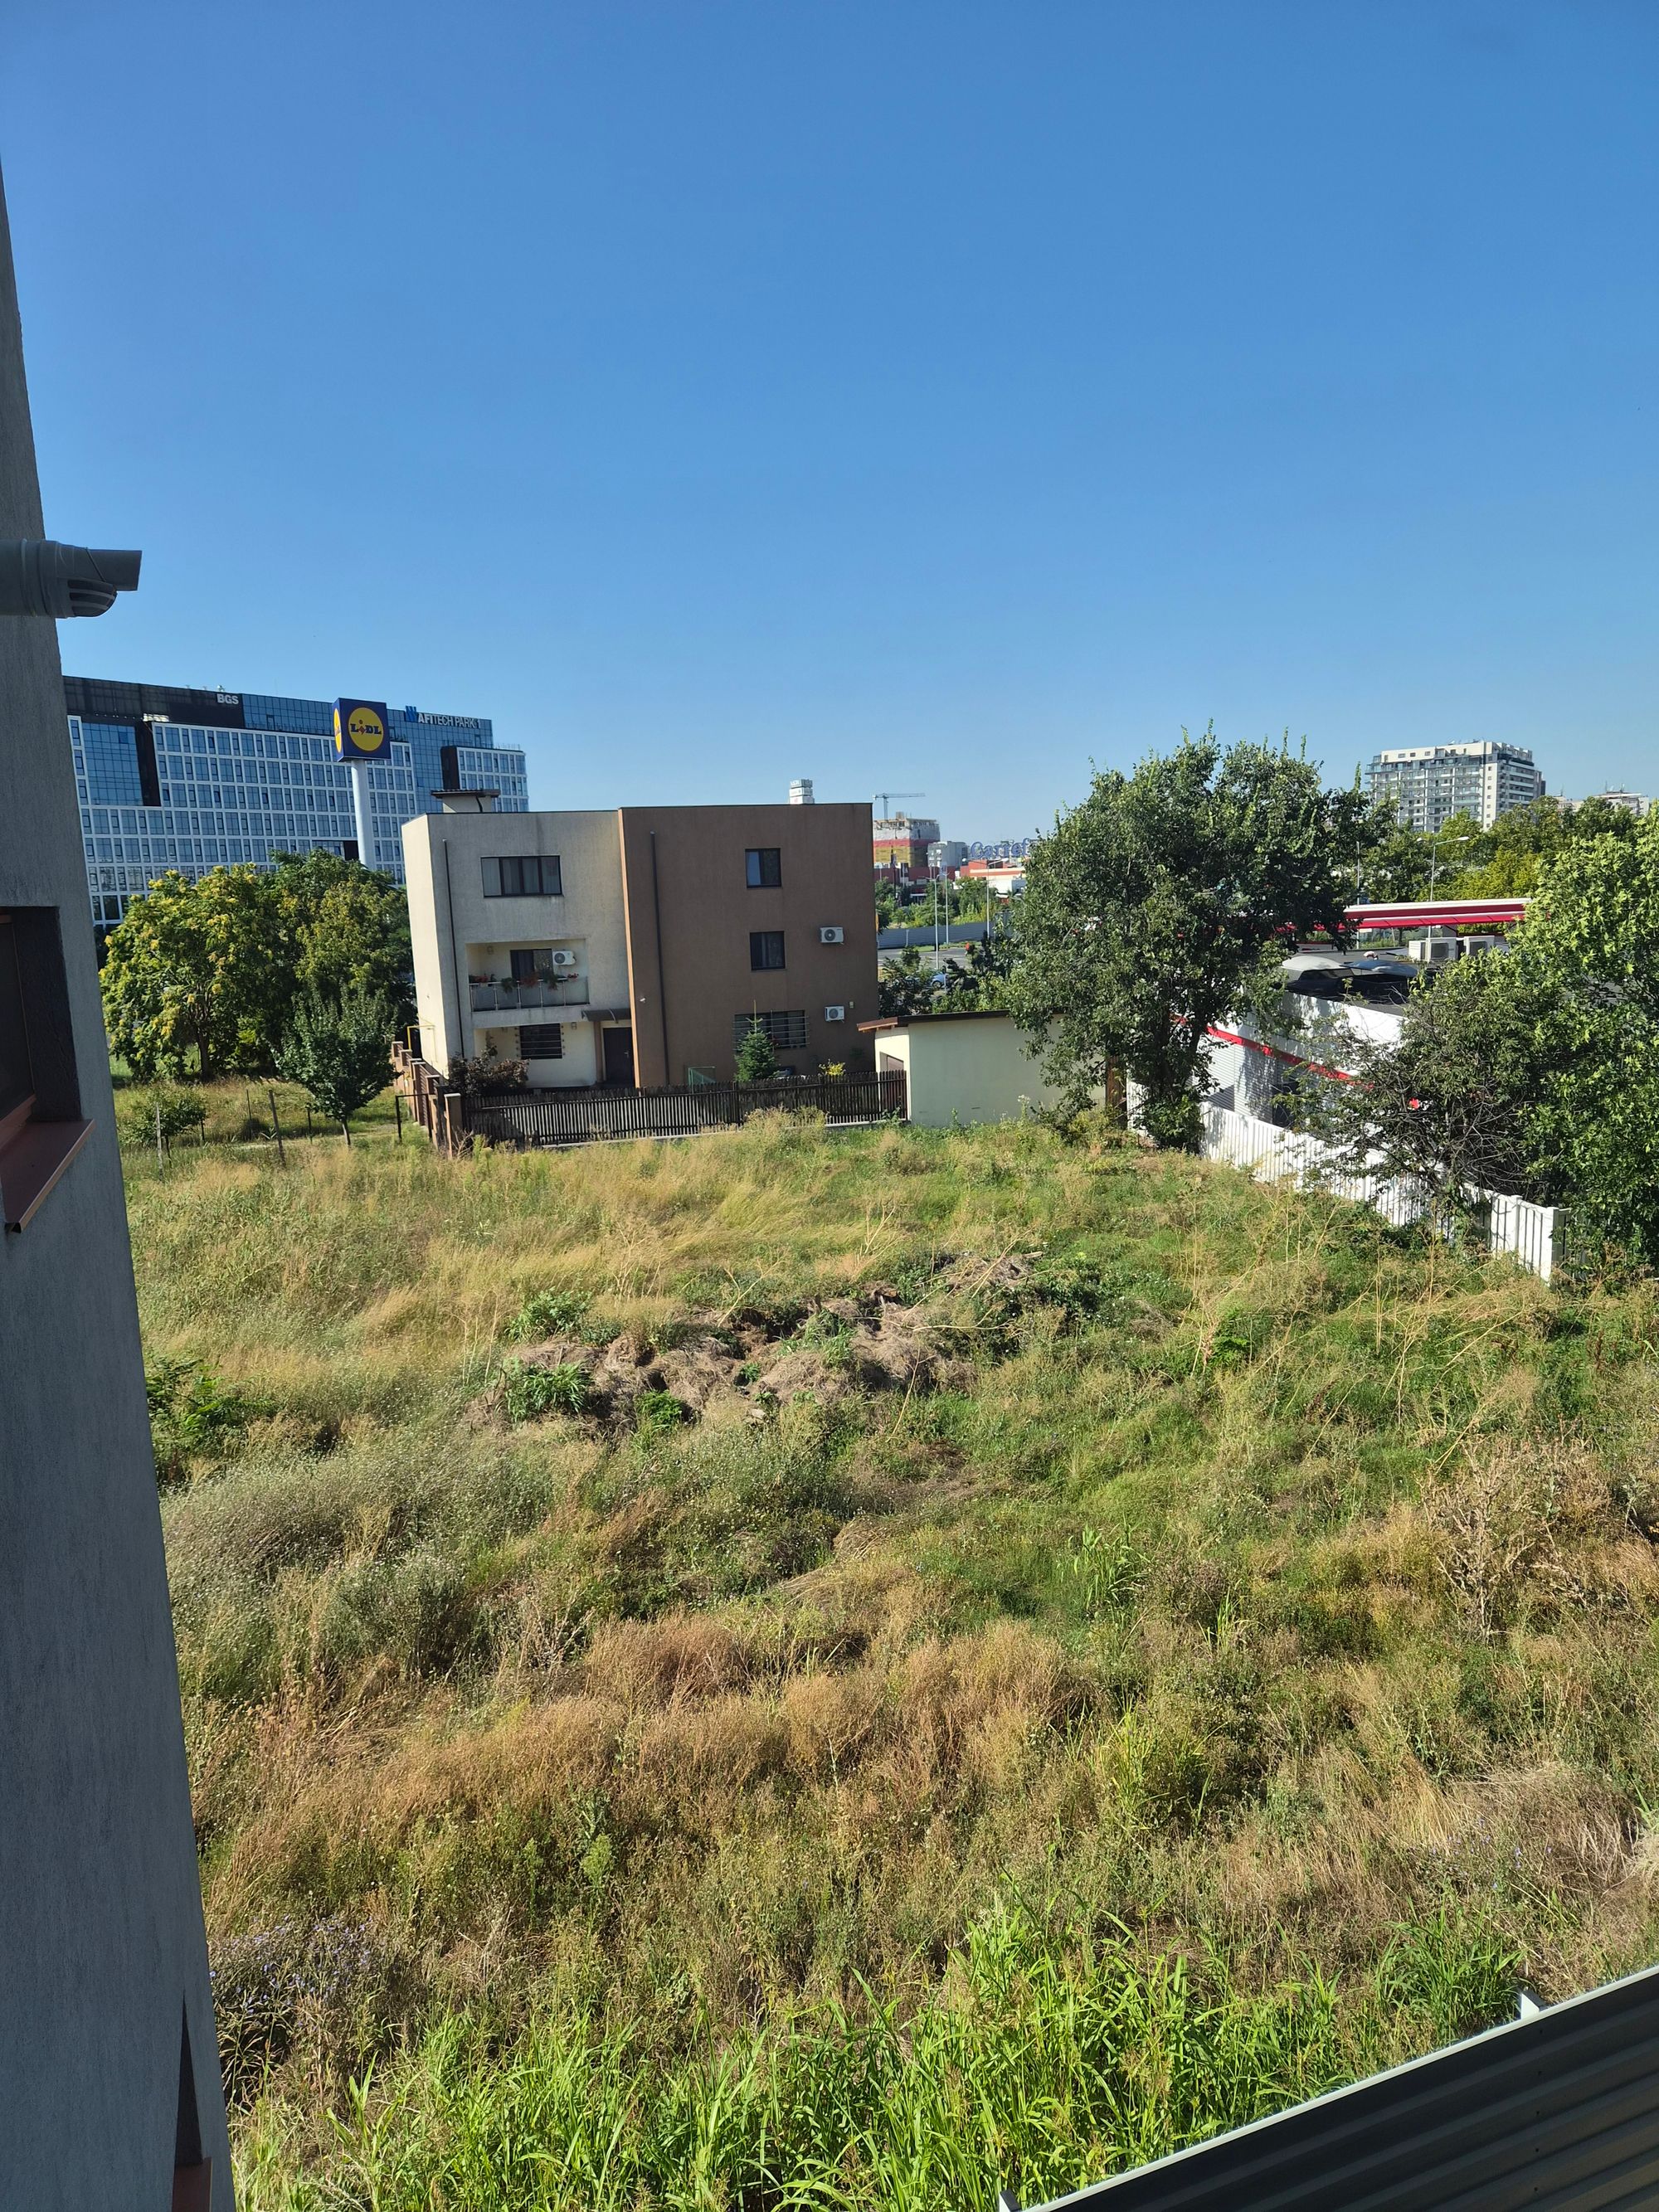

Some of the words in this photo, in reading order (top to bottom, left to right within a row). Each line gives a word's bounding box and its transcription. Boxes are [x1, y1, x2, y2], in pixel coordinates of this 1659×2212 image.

[216, 693, 239, 705] BGS
[455, 717, 475, 729] PARK
[971, 838, 1031, 858] Carref
